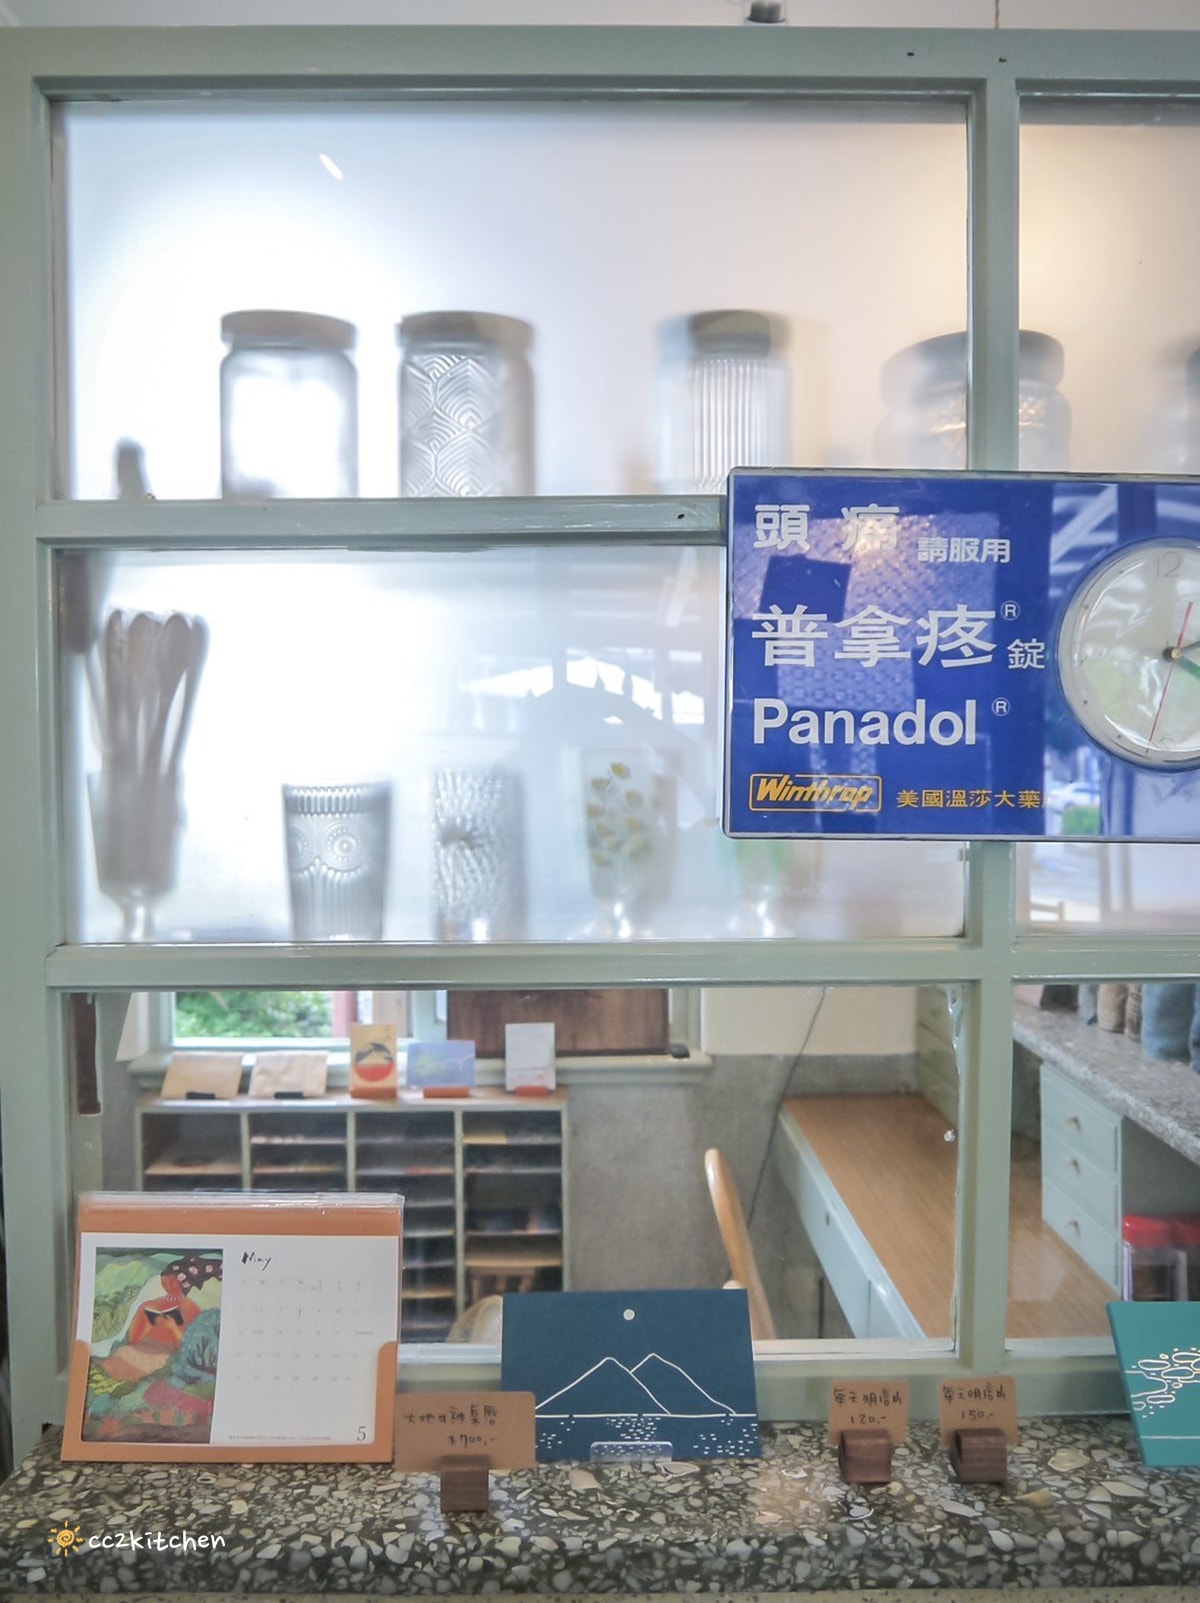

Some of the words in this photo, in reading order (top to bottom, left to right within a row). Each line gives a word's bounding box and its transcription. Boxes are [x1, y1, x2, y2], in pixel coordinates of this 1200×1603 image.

[917, 537, 1011, 563] 請服用
[752, 604, 997, 668] 普拿疼
[1007, 638, 1046, 669] 錠
[753, 698, 977, 746] Panadol
[756, 774, 874, 811] Winthrop
[241, 1251, 272, 1272] May
[356, 1425, 367, 1442] 5
